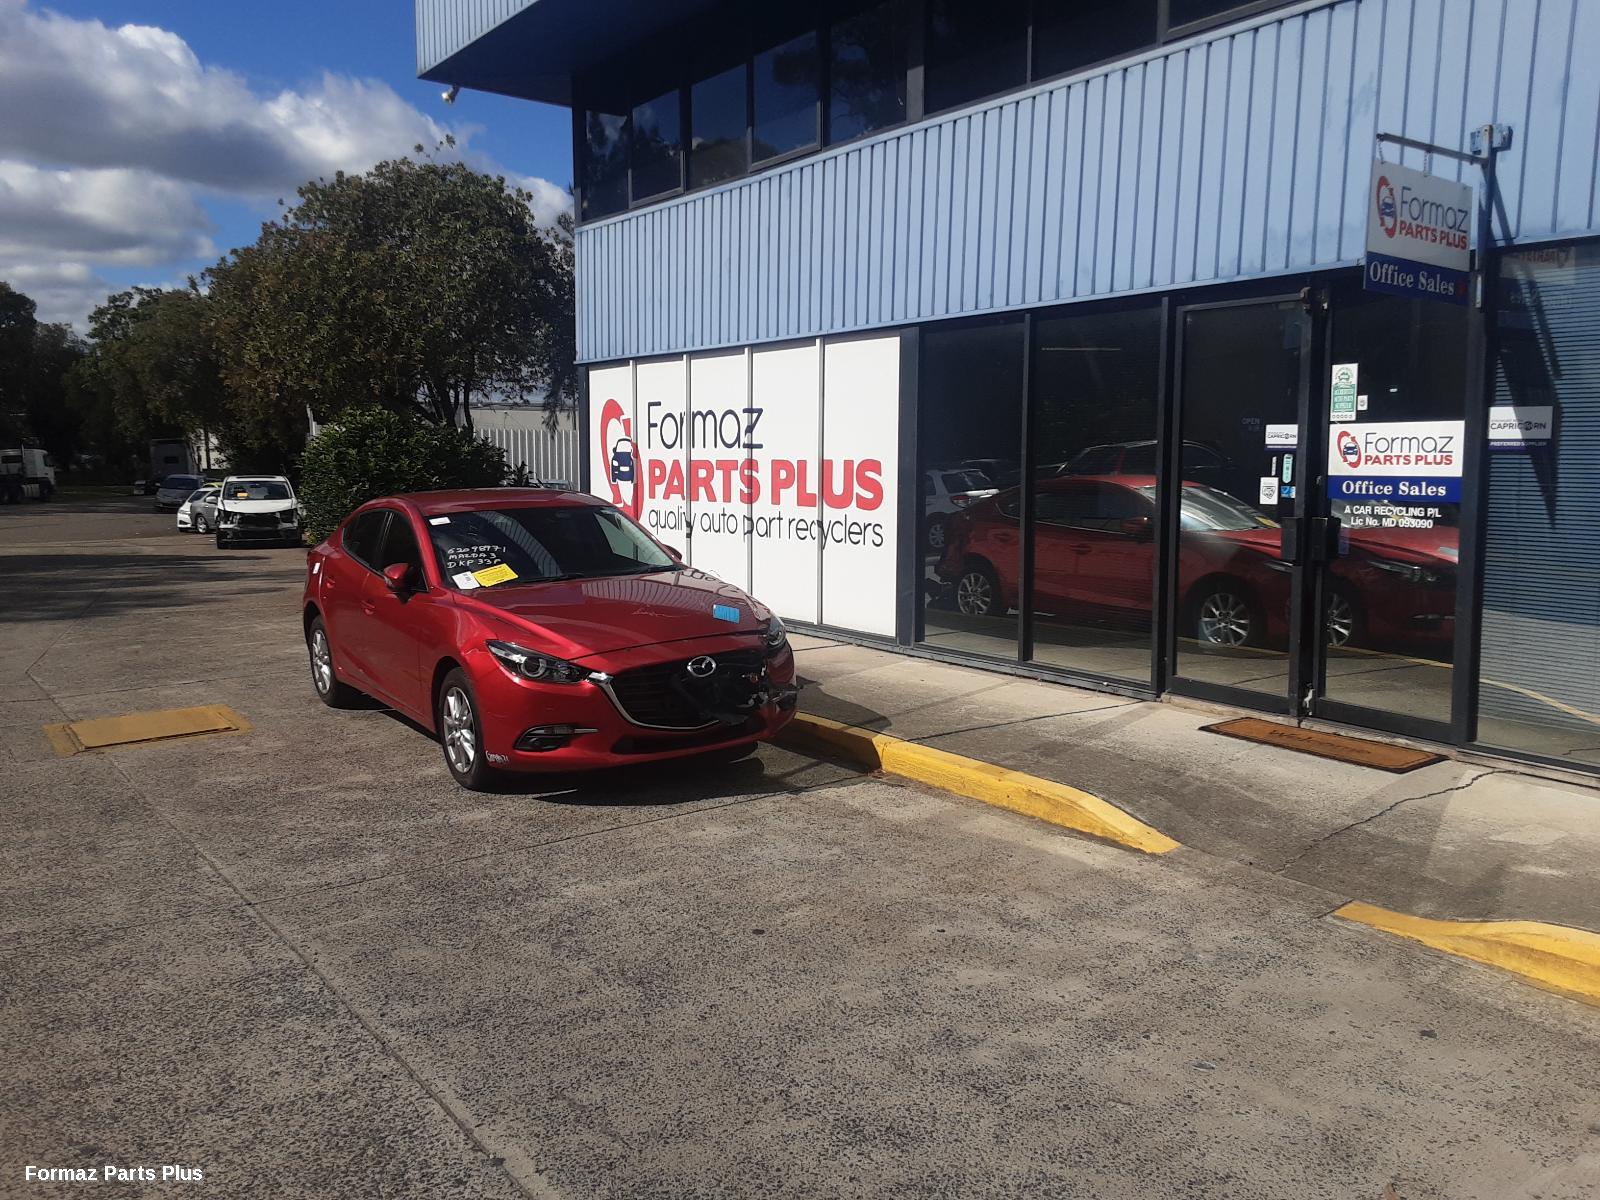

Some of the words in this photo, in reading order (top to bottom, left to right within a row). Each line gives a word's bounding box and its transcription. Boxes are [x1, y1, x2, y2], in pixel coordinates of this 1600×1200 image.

[1400, 186, 1468, 232] Formaz
[1399, 220, 1437, 243] PARTS
[1439, 232, 1467, 250] PLUS
[1369, 261, 1414, 288] Office
[1418, 271, 1455, 296] Sales
[647, 401, 763, 449] Formaz
[1364, 432, 1454, 454] Formaz
[1364, 454, 1412, 466] PARTS
[1415, 454, 1453, 466] PLUS
[648, 458, 760, 504] PARTS
[771, 459, 884, 511] PLUS
[1342, 480, 1393, 496] Office
[1398, 481, 1447, 497] Sales
[1344, 505, 1351, 514] A
[1352, 505, 1372, 515] CAR
[1374, 506, 1425, 517] RECYCLING
[1350, 517, 1364, 526] Lic
[1382, 518, 1396, 528] MD
[700, 507, 738, 534] auto
[743, 511, 783, 543] part
[788, 514, 884, 549] recyclers
[448, 552, 488, 560] MAZDA
